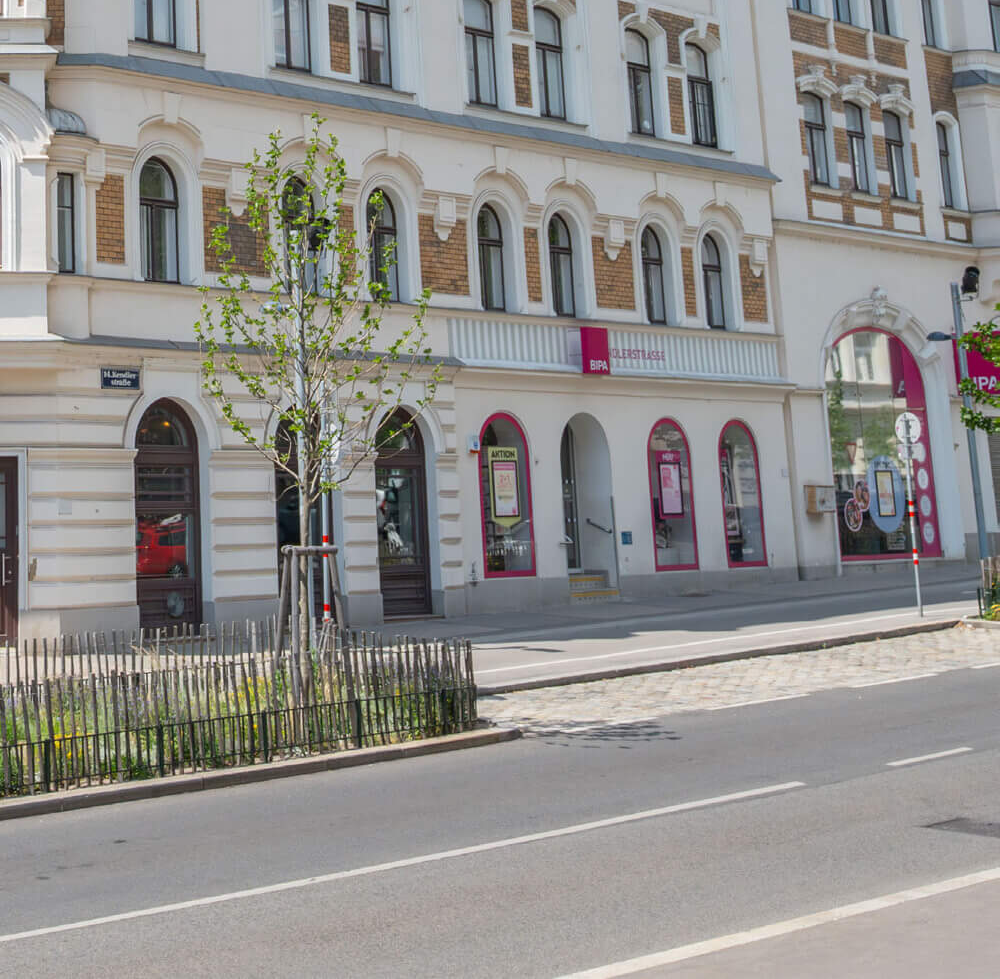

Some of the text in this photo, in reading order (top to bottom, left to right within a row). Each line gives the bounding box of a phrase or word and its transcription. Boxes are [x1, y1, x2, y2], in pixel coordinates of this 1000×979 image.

[609, 347, 665, 361] DLERSTRASSE
[590, 359, 608, 371] BIPA
[966, 375, 997, 390] IPA
[491, 450, 515, 458] AKTION
